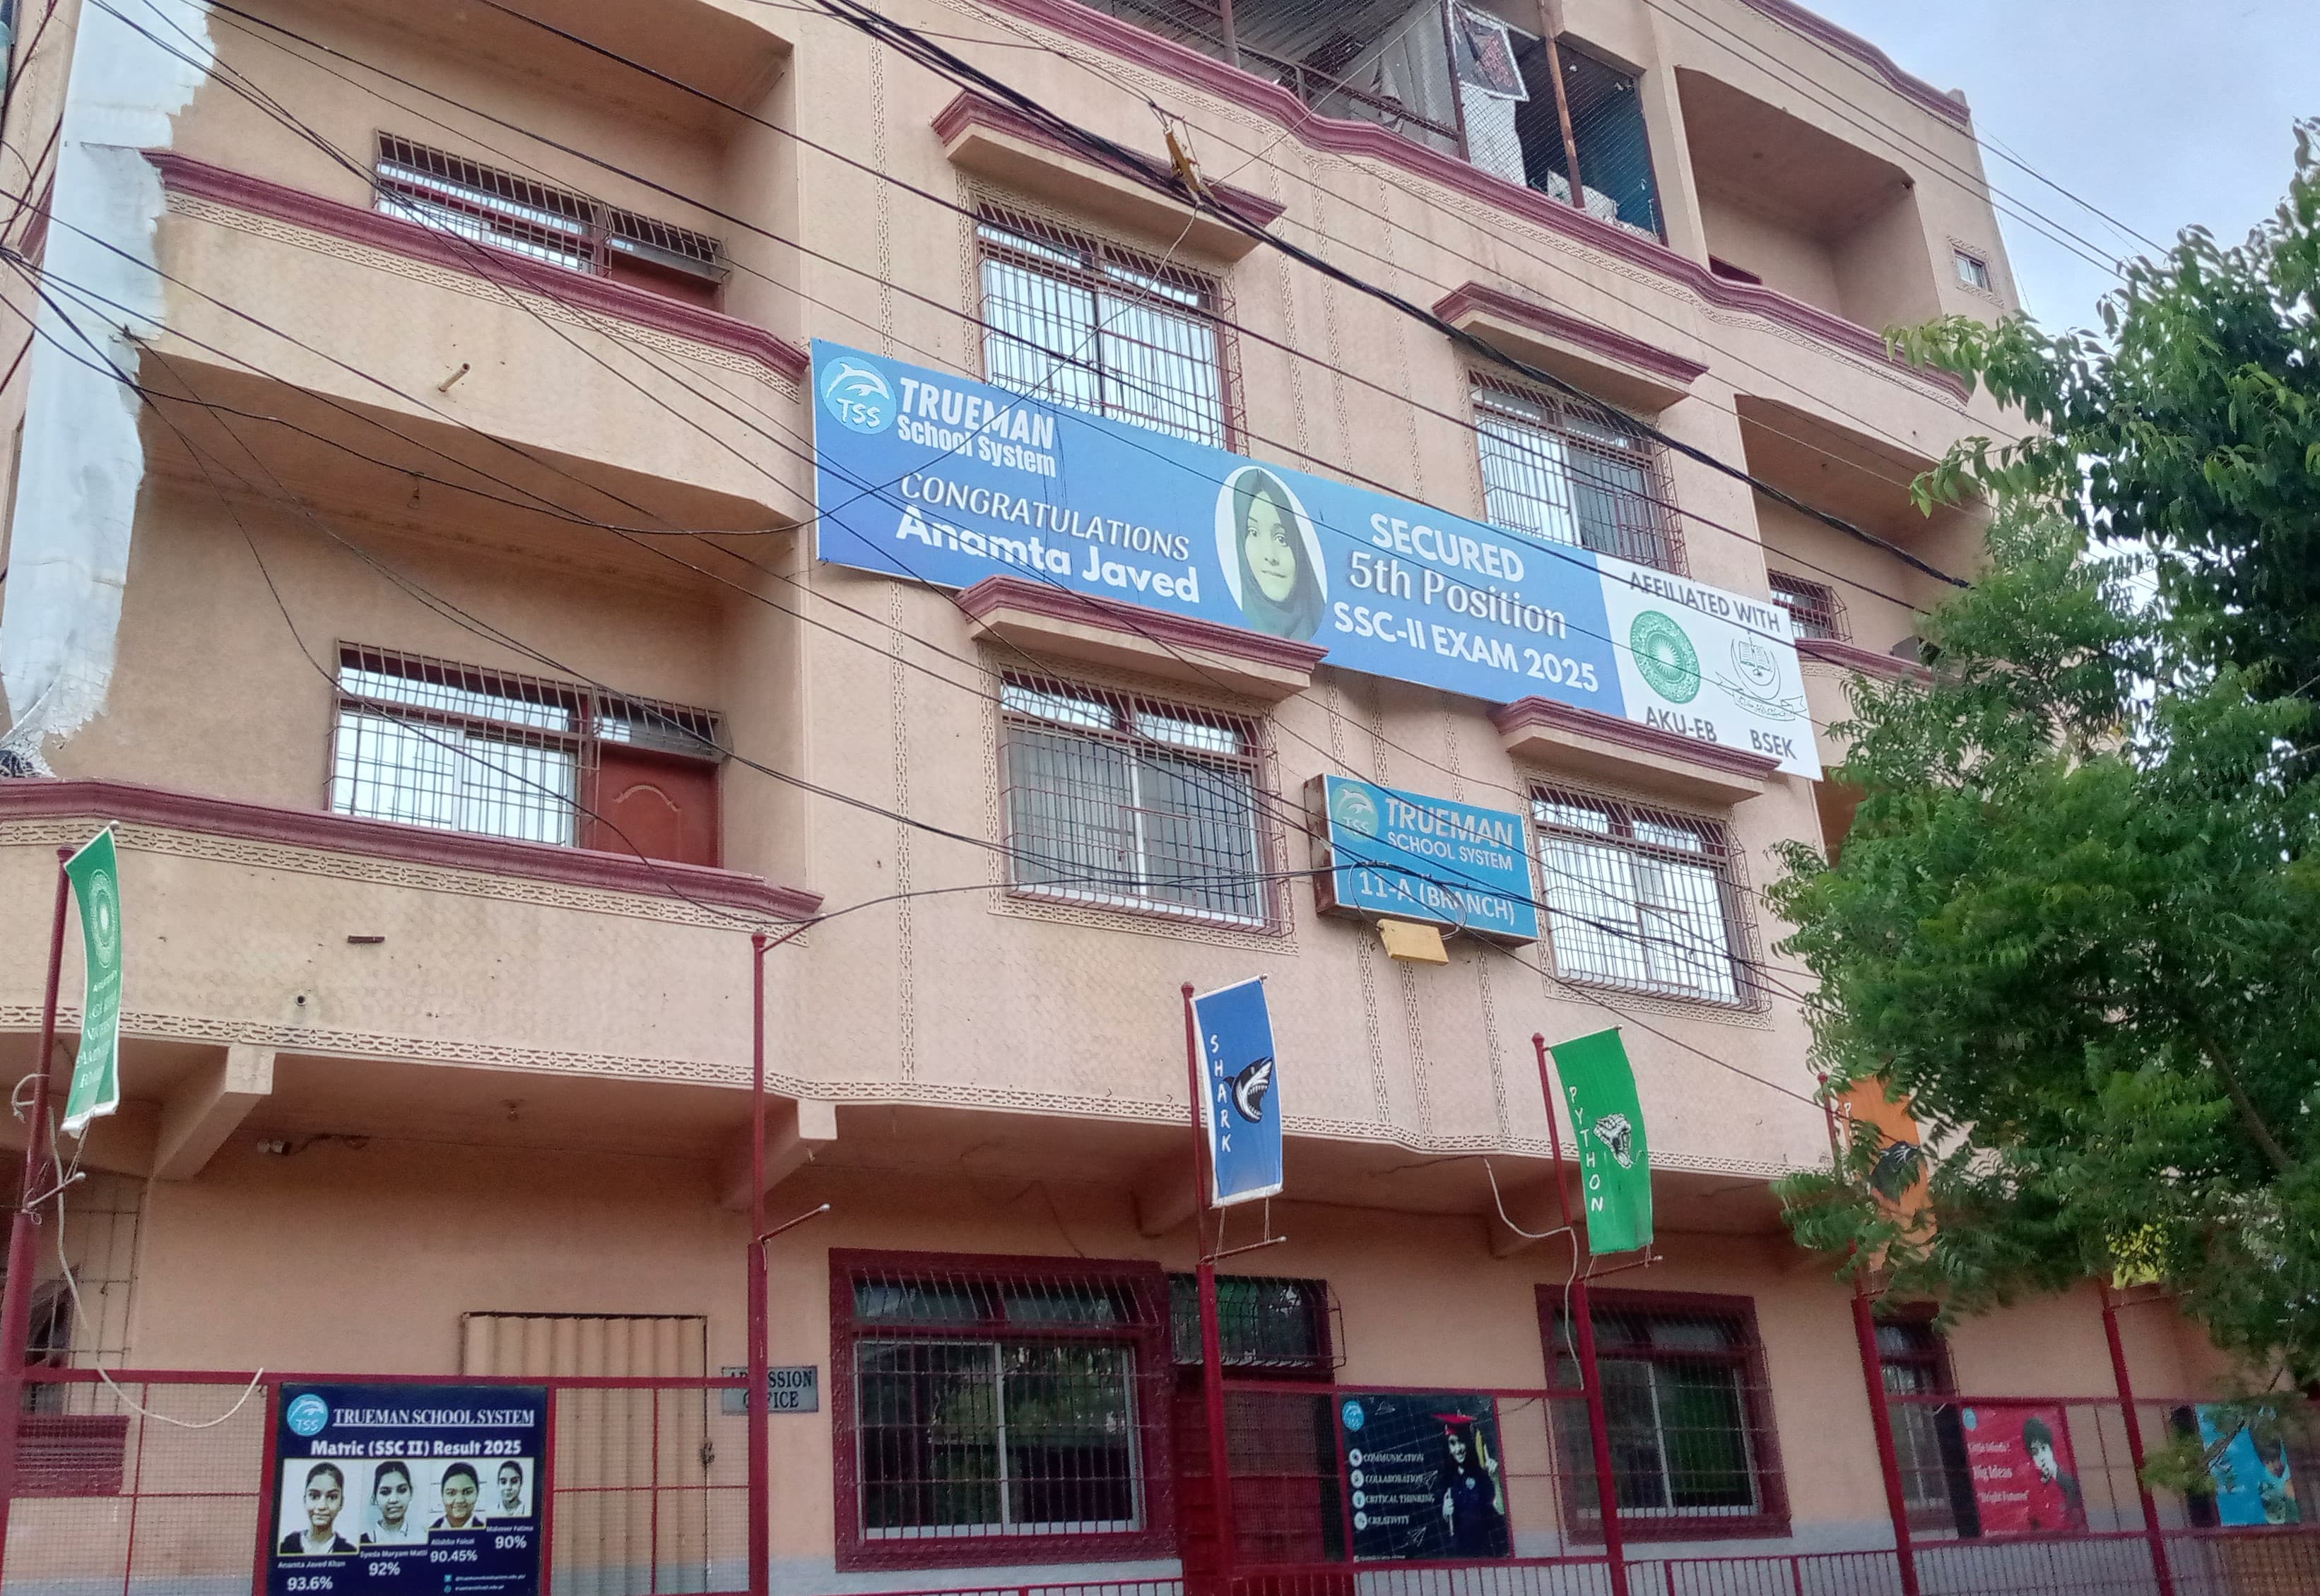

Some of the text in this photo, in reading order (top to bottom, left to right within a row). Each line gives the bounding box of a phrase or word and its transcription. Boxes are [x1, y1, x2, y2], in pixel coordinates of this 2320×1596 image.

[836, 397, 881, 428] TSS
[900, 377, 1054, 450] TRUEMAN
[897, 414, 1056, 478] School System
[901, 474, 1190, 561] CONGRATULATIONS
[896, 504, 1201, 604] Anamta Javed
[1370, 512, 1524, 582] SECURED
[1349, 551, 1567, 639] 5th Position
[1630, 571, 1781, 633] AFFILIATED WITH
[1333, 601, 1599, 693] SSC-II EXAM 2025
[1647, 706, 1718, 743] AKU-EB
[1750, 728, 1798, 760] BSEK
[1385, 798, 1514, 851] TRUEMAN
[1387, 832, 1514, 871] SCHOOL SYSTEM
[1359, 871, 1515, 926] 11-A (BRANCH)
[1209, 1034, 1232, 1153] SHARK
[1568, 1086, 1604, 1212] PYTHON
[730, 1370, 813, 1388] SSION
[295, 1419, 319, 1432] TSS
[333, 1408, 535, 1425] TRUEMAN SCHOOL SYSTEM
[310, 1439, 522, 1457] Matric (SSC II) Result 2025
[1362, 1453, 1425, 1463] COMMUNICATION
[1365, 1494, 1398, 1503] CRITICAL
[1368, 1515, 1410, 1525] CREATIVITY
[430, 1549, 478, 1563] 90.45%
[495, 1535, 527, 1549] 90%
[287, 1576, 334, 1591] 93.6%
[369, 1562, 401, 1576] 92%
